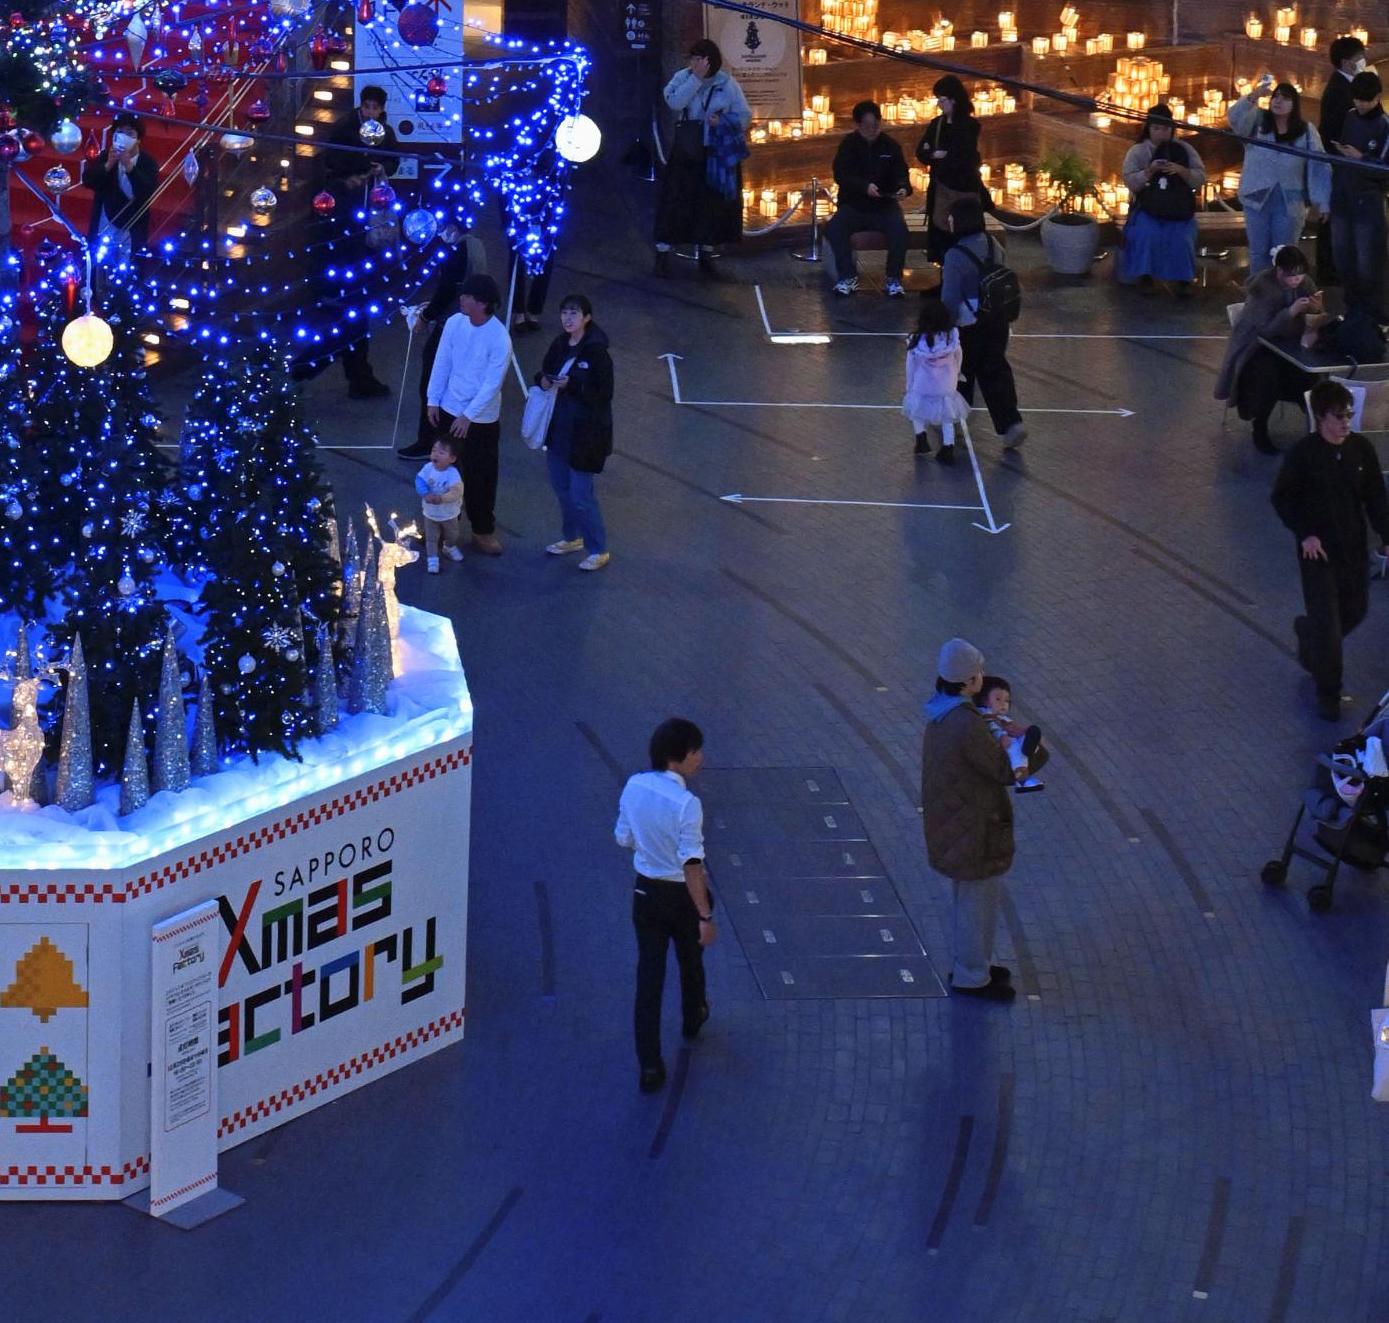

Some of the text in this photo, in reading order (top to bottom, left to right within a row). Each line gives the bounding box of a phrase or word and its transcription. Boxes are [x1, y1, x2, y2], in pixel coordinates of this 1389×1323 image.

[216, 859, 393, 988] Xmas
[275, 828, 394, 896] SAPPORO
[218, 916, 444, 1068] actory
